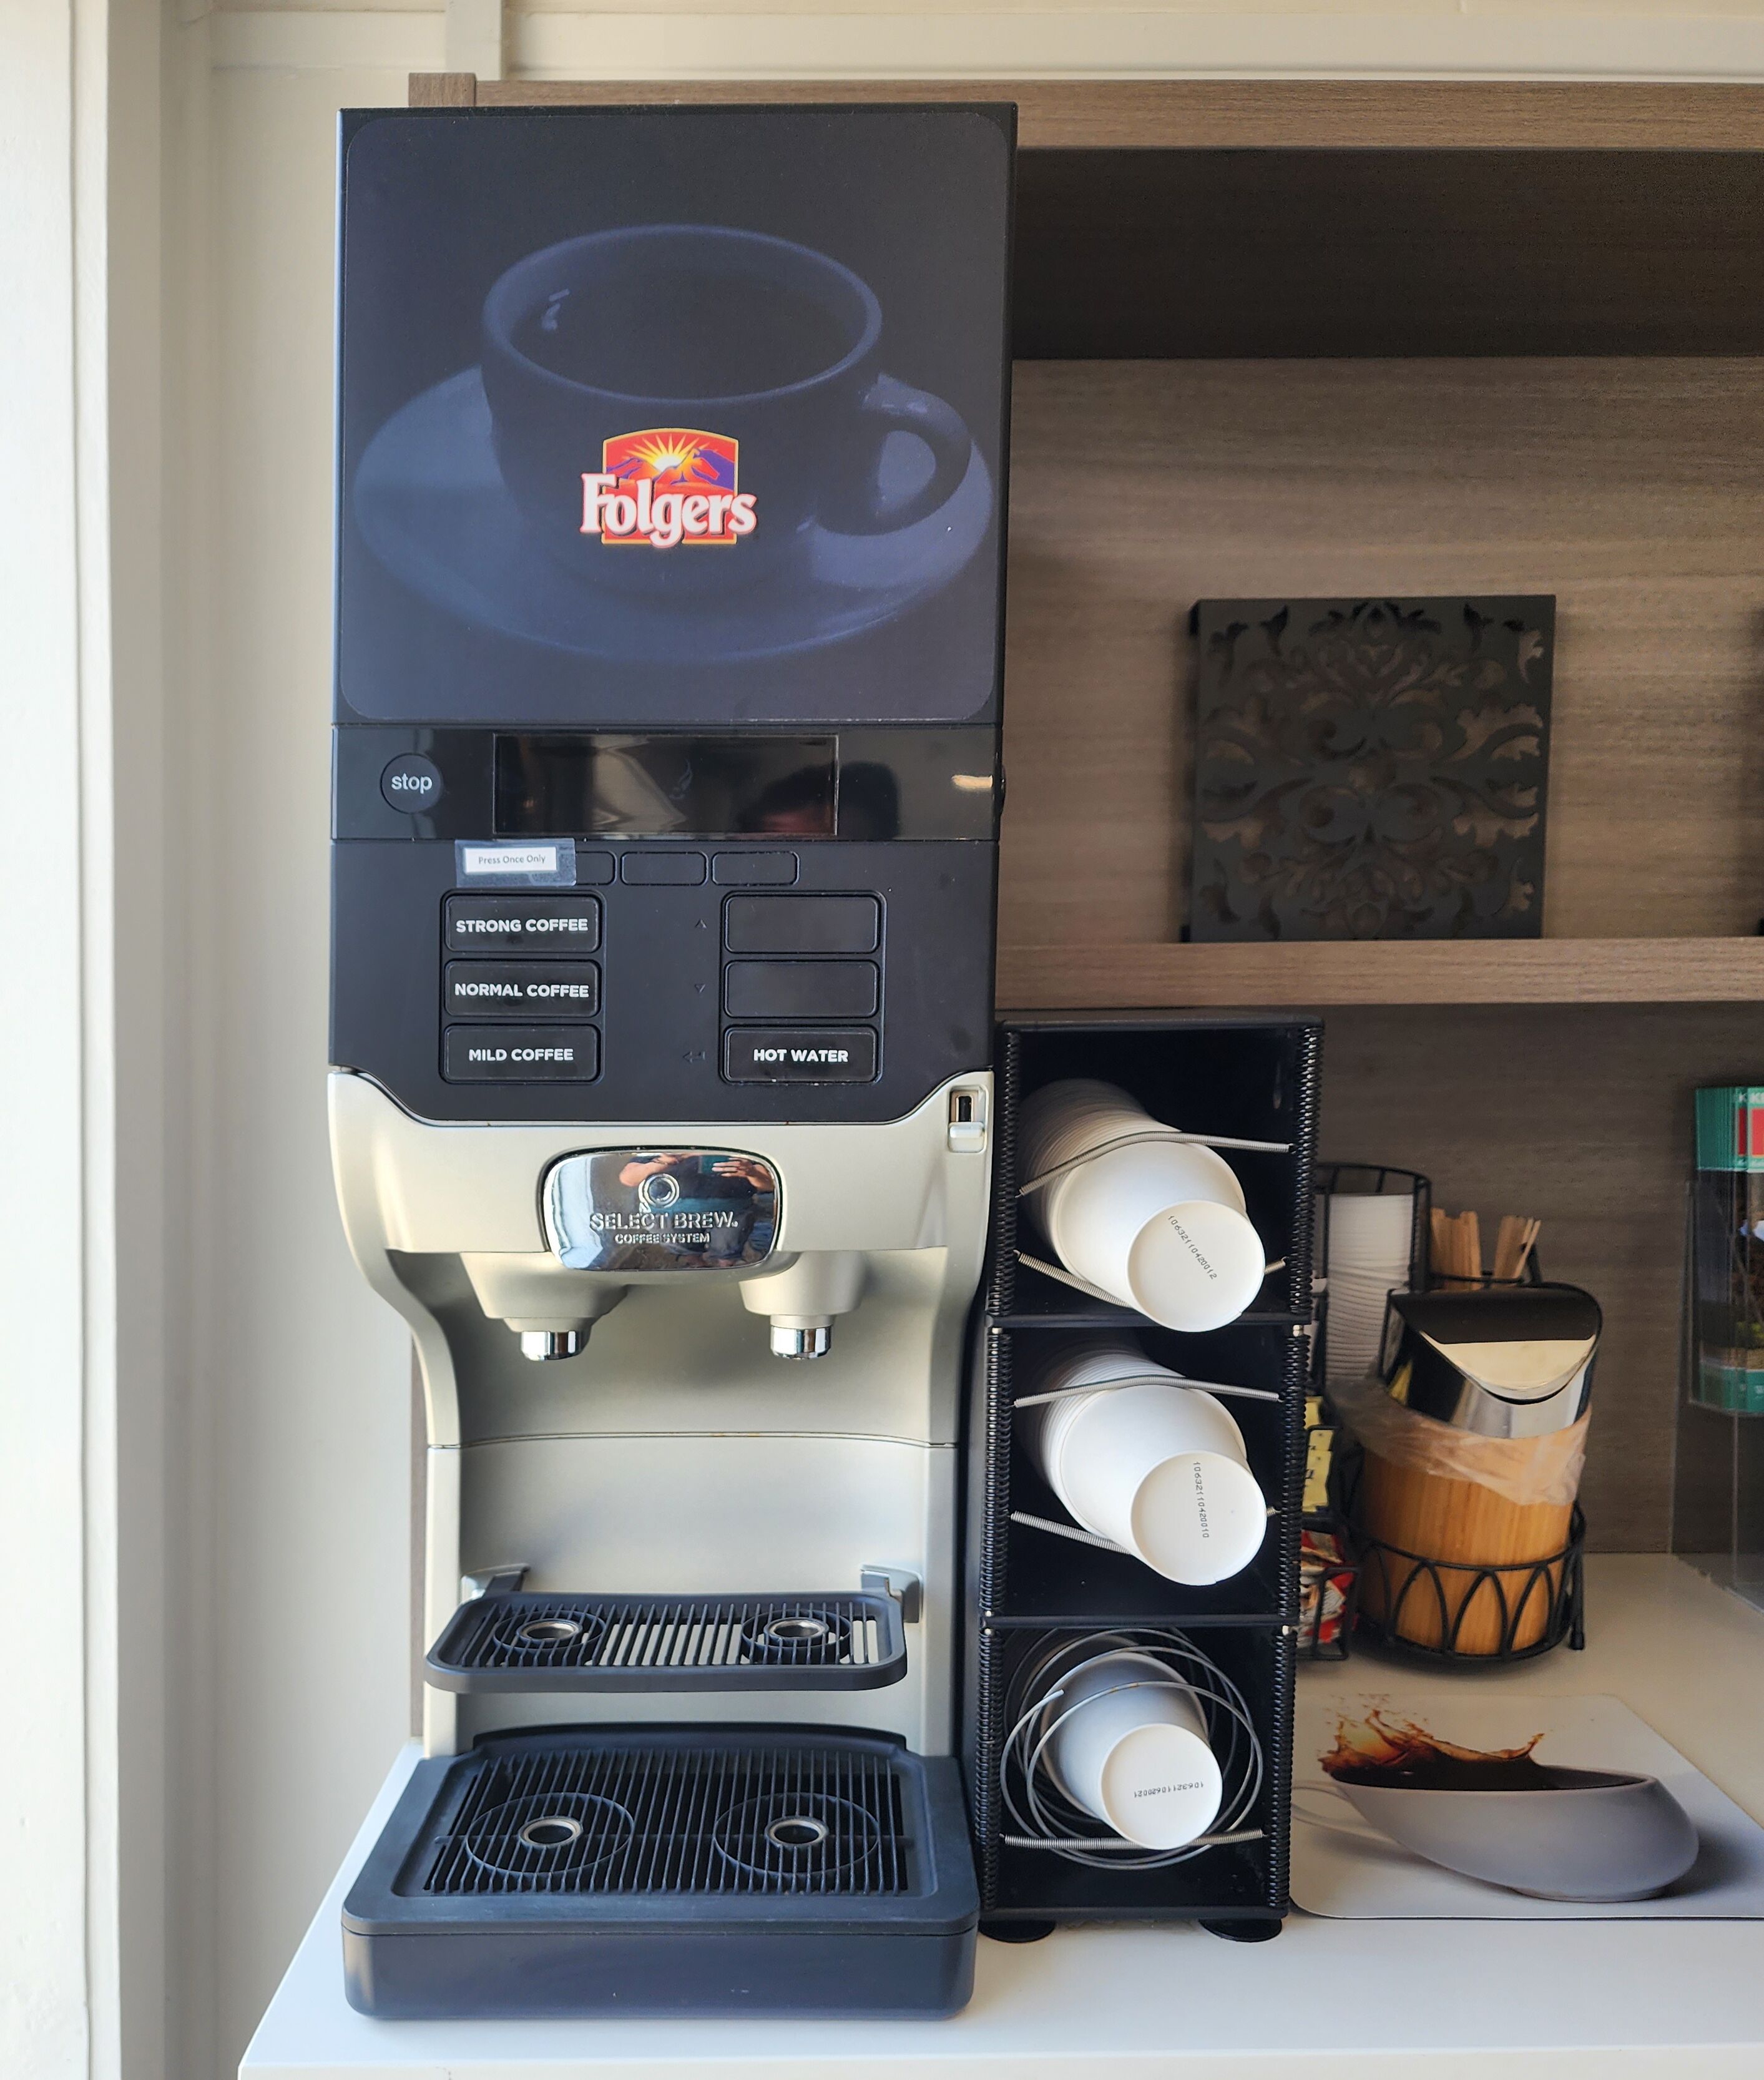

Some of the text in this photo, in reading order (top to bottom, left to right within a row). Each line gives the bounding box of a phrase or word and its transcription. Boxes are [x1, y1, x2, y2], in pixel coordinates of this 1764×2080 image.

[580, 473, 757, 549] Folgers
[391, 773, 433, 793] stop
[478, 854, 546, 865] Press Once Only
[456, 918, 589, 933] STRONG COFFEE
[454, 983, 589, 998] NORMAL COFFEE
[469, 1048, 574, 1061] MILD COFFEE
[753, 1049, 849, 1062] HOT WATER
[590, 1212, 669, 1230] SELECT
[614, 1232, 710, 1244] COFFEE SYSTEM
